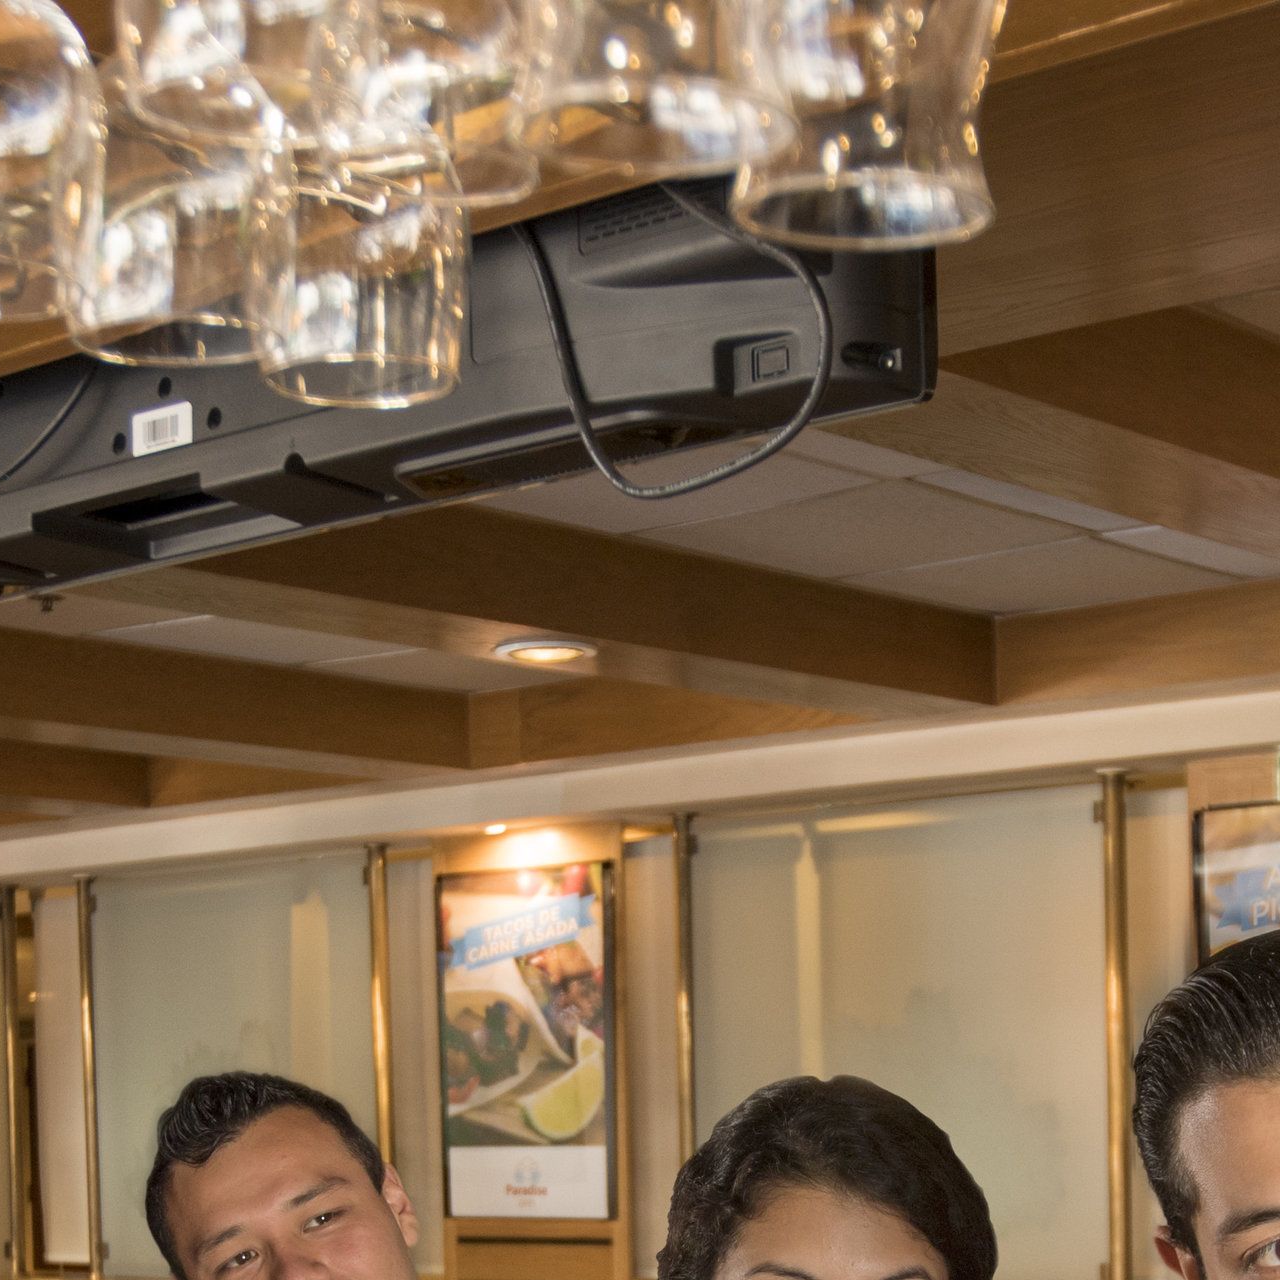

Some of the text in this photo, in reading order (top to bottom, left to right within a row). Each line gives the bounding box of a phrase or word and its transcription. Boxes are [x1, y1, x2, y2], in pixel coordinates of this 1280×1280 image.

[465, 917, 580, 965] CARNE ASADA
[482, 903, 562, 944] TACOS DE
[505, 1183, 549, 1196] Paradise
